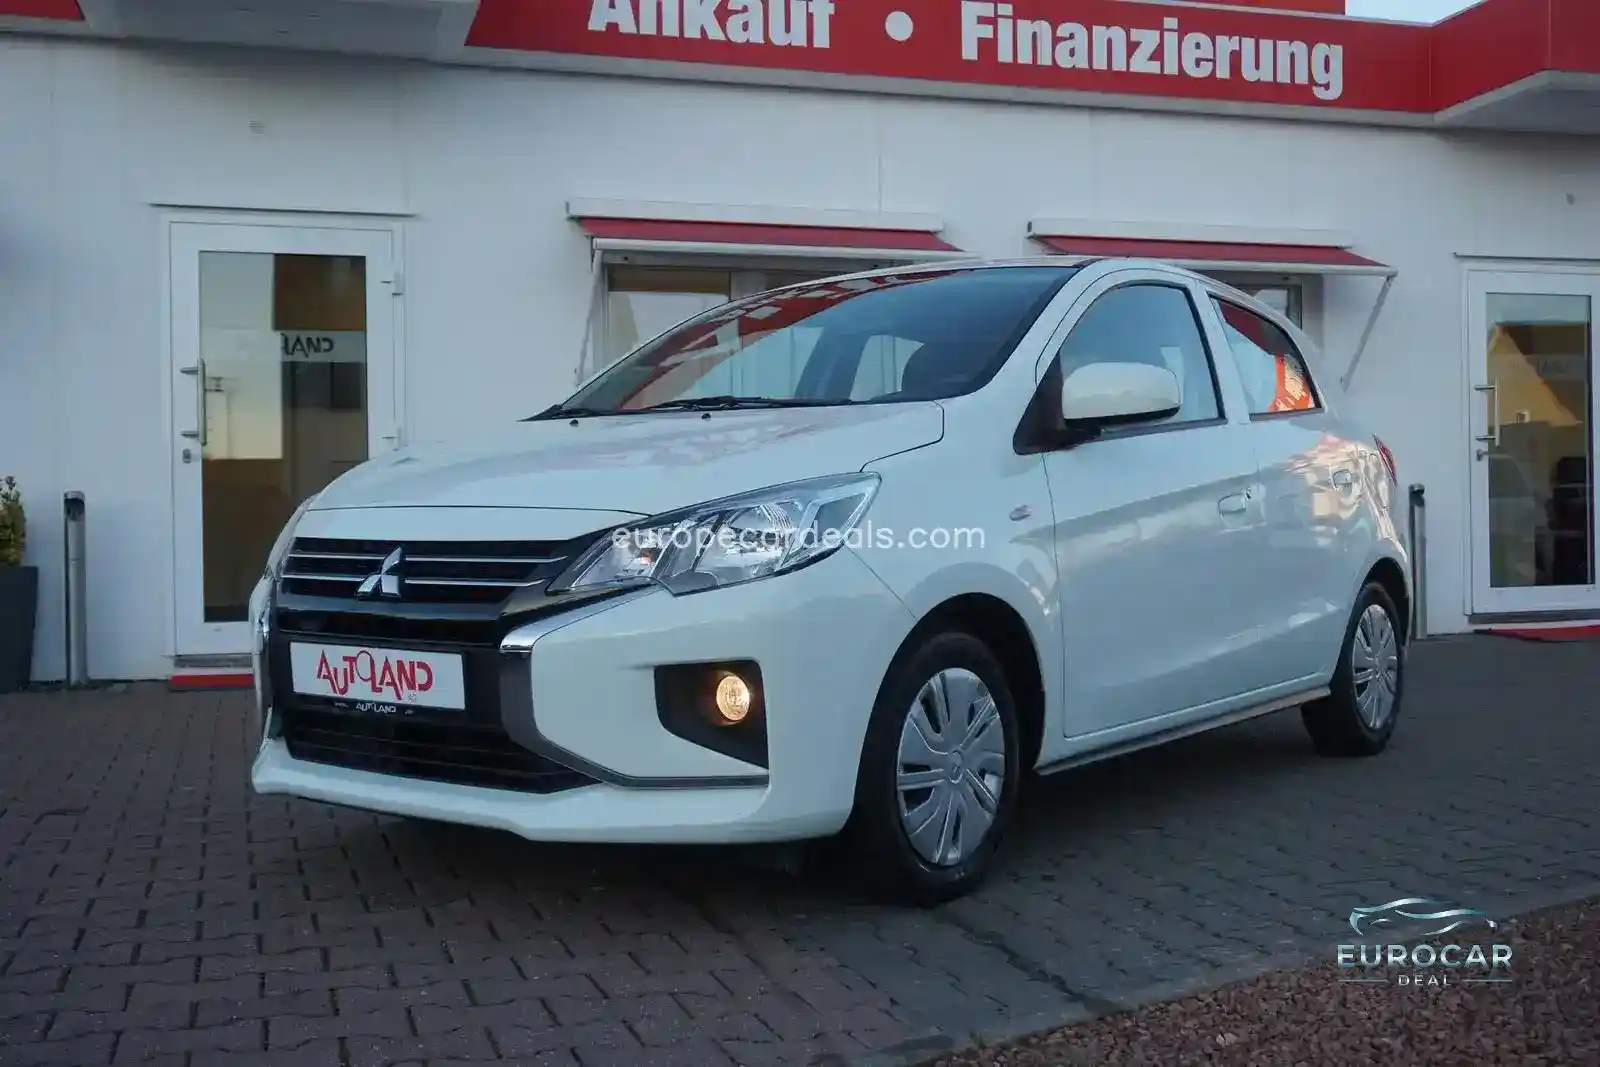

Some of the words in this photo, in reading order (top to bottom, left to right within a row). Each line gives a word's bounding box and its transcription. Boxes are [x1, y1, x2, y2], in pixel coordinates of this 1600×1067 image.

[588, 0, 834, 48] Ankauf
[961, 1, 1343, 100] Finanzierung
[317, 650, 433, 700] AUTOLAND
